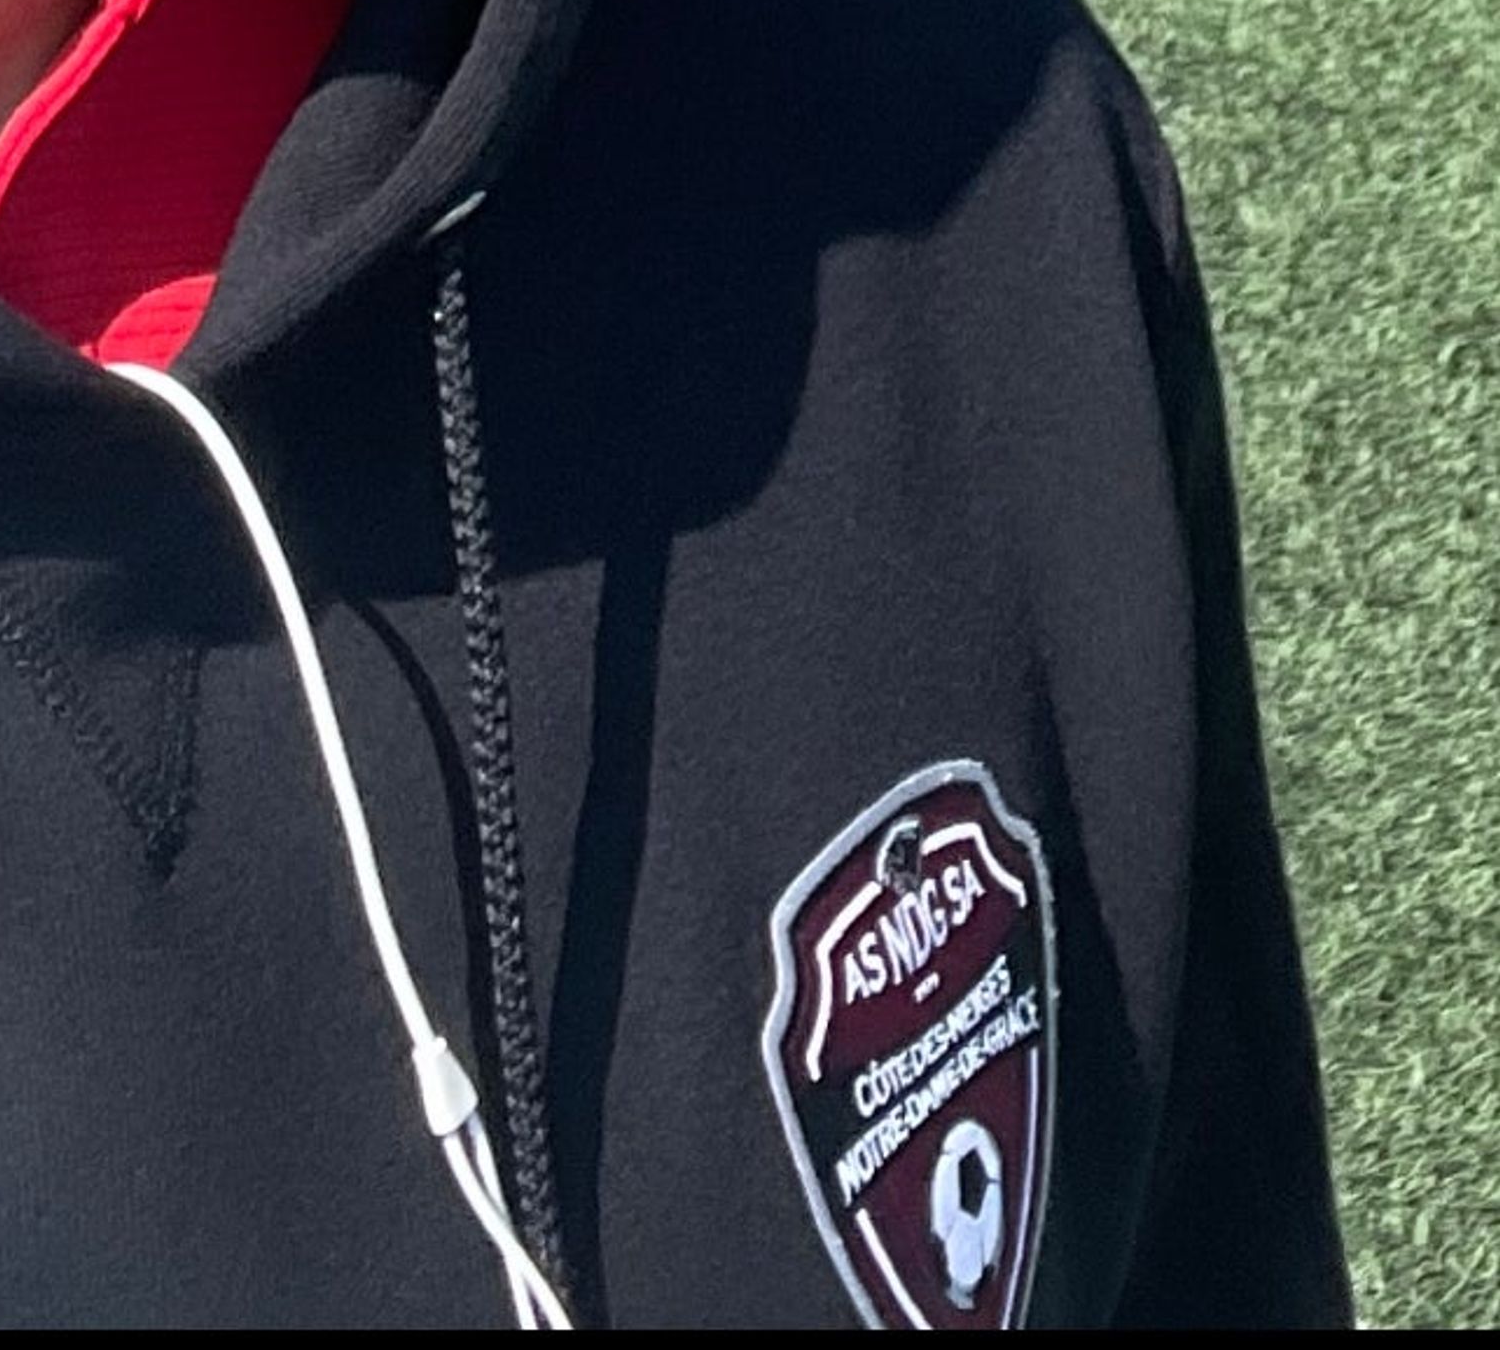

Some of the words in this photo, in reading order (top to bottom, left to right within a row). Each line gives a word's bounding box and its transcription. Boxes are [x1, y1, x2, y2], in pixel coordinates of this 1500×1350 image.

[843, 931, 888, 1006] AS
[878, 878, 949, 986] NDG
[942, 859, 987, 926] SA
